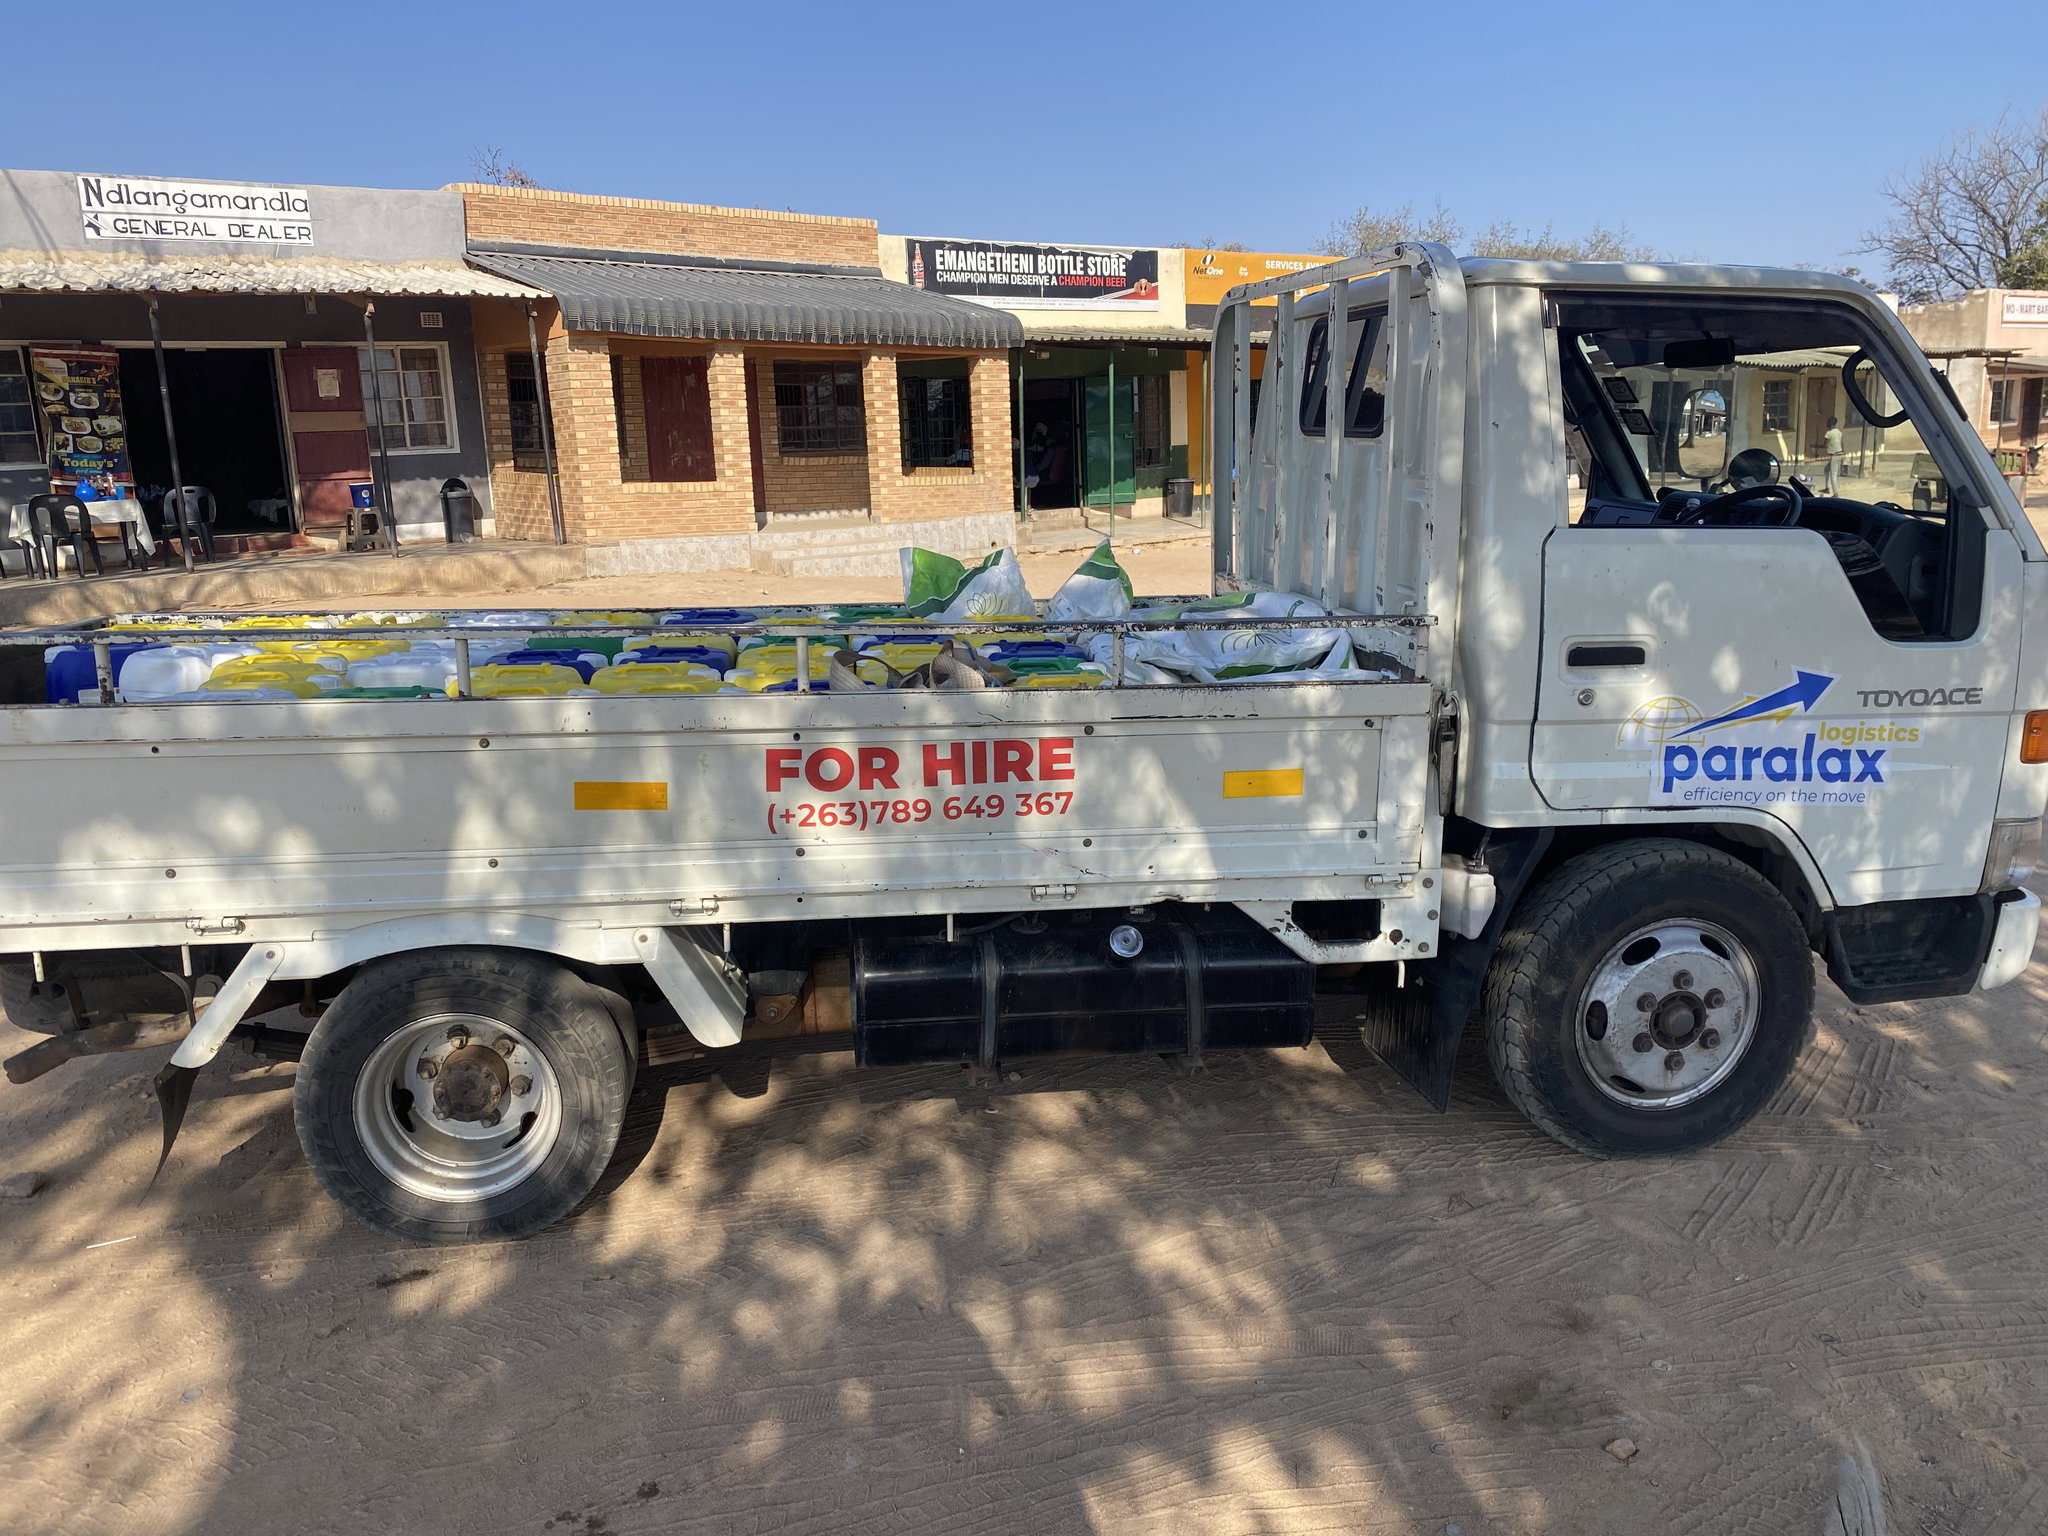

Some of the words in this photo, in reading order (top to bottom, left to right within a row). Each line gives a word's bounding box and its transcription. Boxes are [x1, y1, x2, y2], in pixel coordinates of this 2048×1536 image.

[82, 177, 309, 214] Ndlangamandla
[113, 217, 217, 237] GENERAL
[228, 223, 312, 241] DEALER
[935, 249, 1034, 274] EMANGETHENI
[1037, 254, 1085, 276] BOTTLE
[1087, 256, 1127, 277] STORE
[1193, 266, 1224, 276] NetOne
[1265, 260, 1304, 271] SERVICES
[936, 271, 987, 284] CHAMPION
[988, 273, 1010, 285] MEN
[1010, 274, 1050, 286] DESERVE
[1051, 275, 1058, 286] A
[1058, 275, 1104, 287] CHAMPION
[1105, 276, 1127, 288] BEER
[1857, 687, 1983, 708] TOYOACE
[1819, 721, 1920, 746] logistics
[765, 747, 901, 792] FOR
[922, 738, 1075, 787] HIRE
[1662, 733, 1887, 793] paralax
[1683, 786, 1762, 805] efficiency
[1765, 790, 1787, 802] on
[1791, 788, 1818, 803] the
[1822, 790, 1866, 803] move
[767, 799, 932, 834] (+263)789
[943, 794, 1005, 821] 649
[1014, 791, 1074, 817] 367
